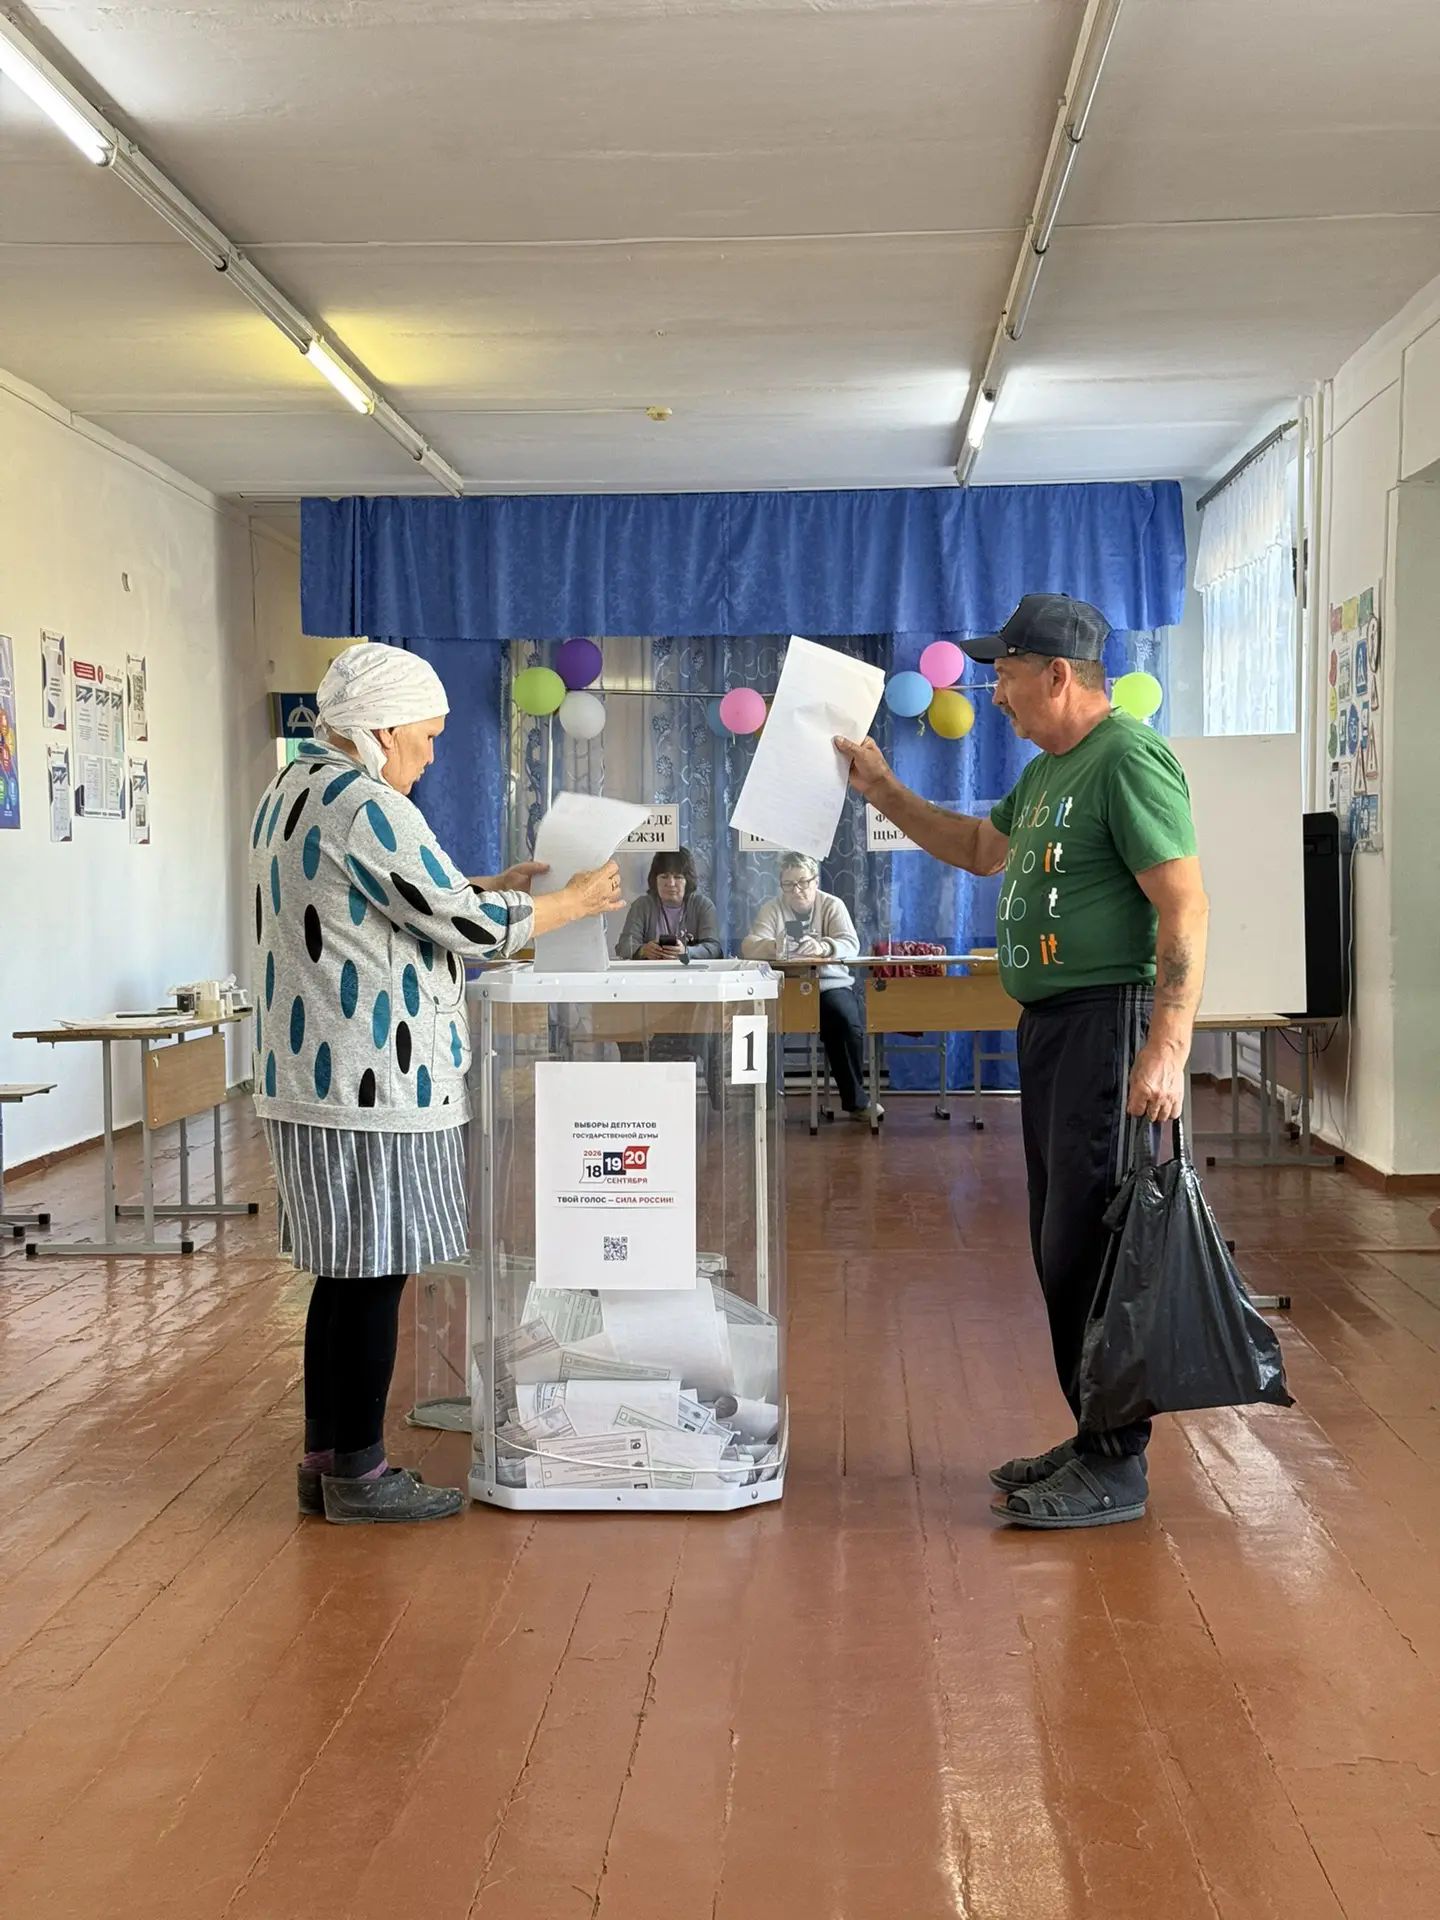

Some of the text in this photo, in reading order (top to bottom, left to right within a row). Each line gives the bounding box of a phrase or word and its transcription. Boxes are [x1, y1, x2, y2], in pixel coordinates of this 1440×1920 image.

[642, 815, 673, 826] ГДЕ
[1055, 796, 1073, 828] it
[1044, 842, 1066, 873] it
[998, 880, 1027, 921] do
[999, 928, 1064, 969] do it
[741, 1030, 758, 1071] 1
[586, 1150, 645, 1178] 18 19 20
[557, 1195, 579, 1203] ТВОЙ
